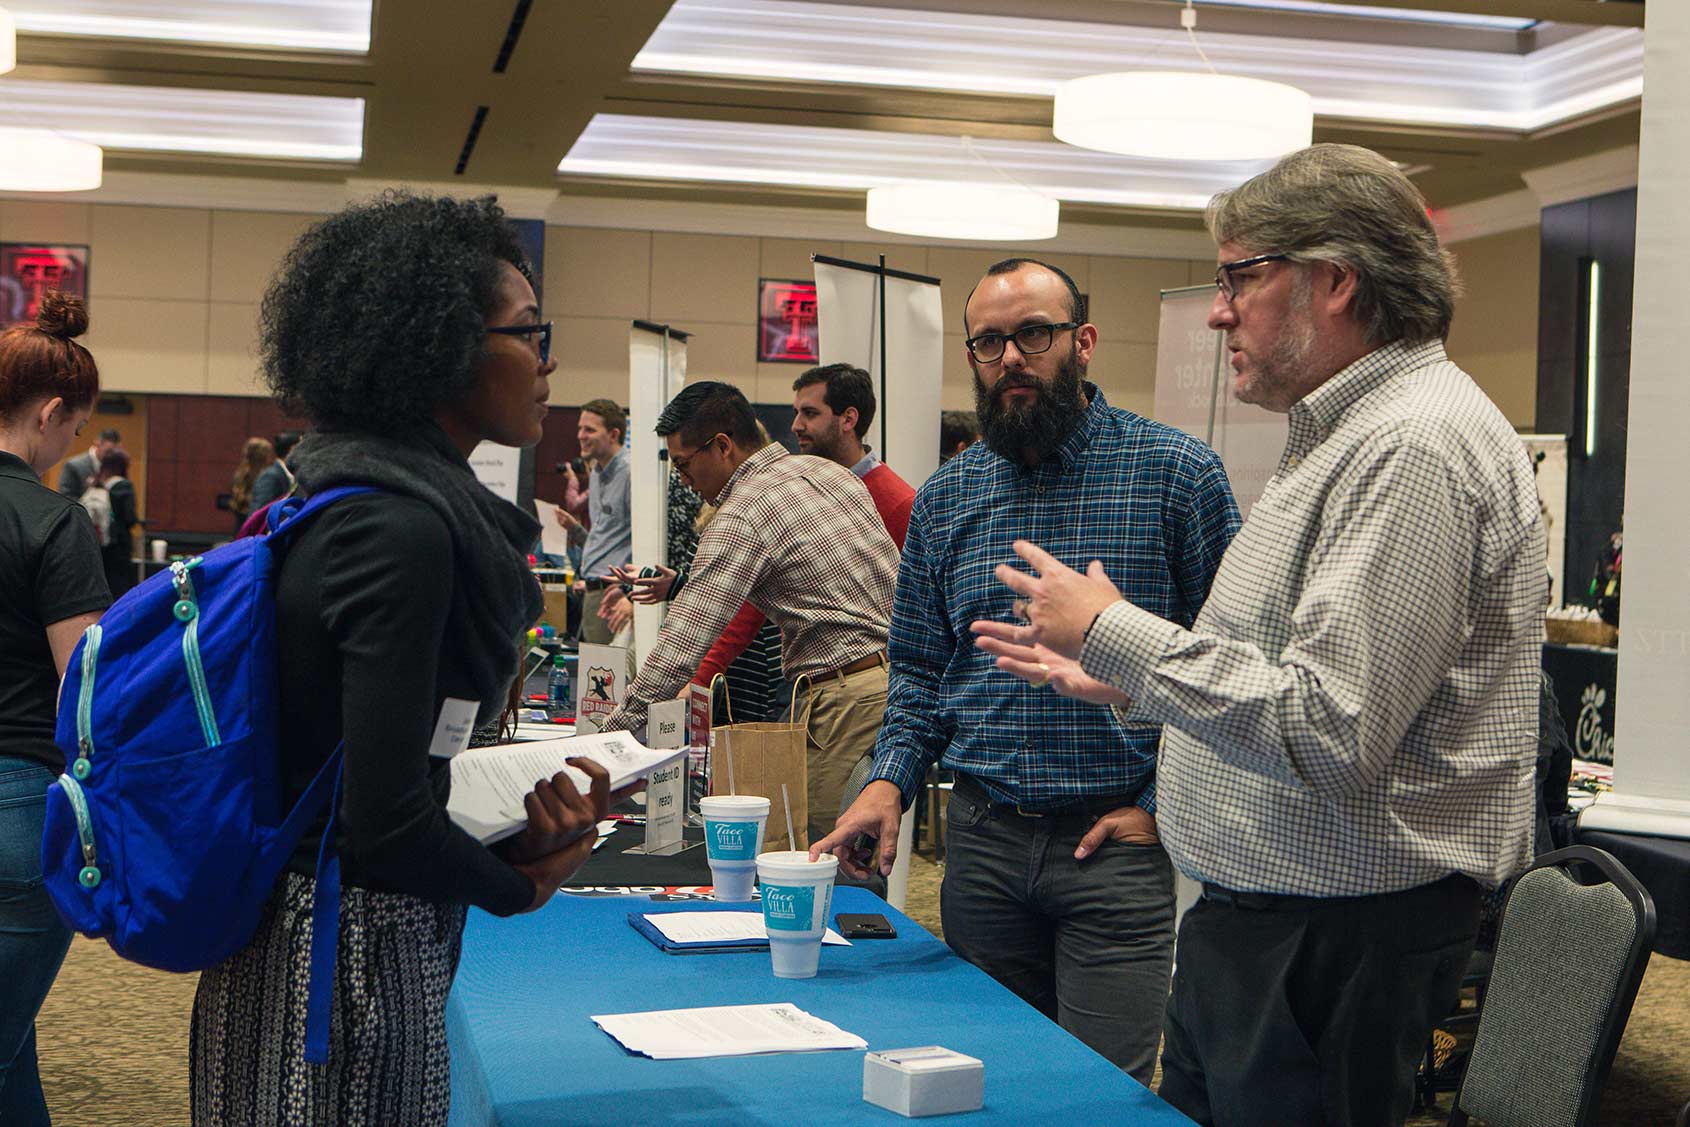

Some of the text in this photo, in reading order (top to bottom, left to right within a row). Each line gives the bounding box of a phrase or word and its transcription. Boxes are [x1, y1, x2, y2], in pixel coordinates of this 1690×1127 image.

[582, 700, 617, 714] RED RAIDE
[659, 721, 676, 735] Please
[653, 766, 680, 785] Student ID
[658, 793, 673, 808] ready
[715, 823, 744, 836] Taco
[717, 834, 743, 846] VILLA
[765, 886, 795, 901] Taco
[768, 900, 794, 913] VILLA
